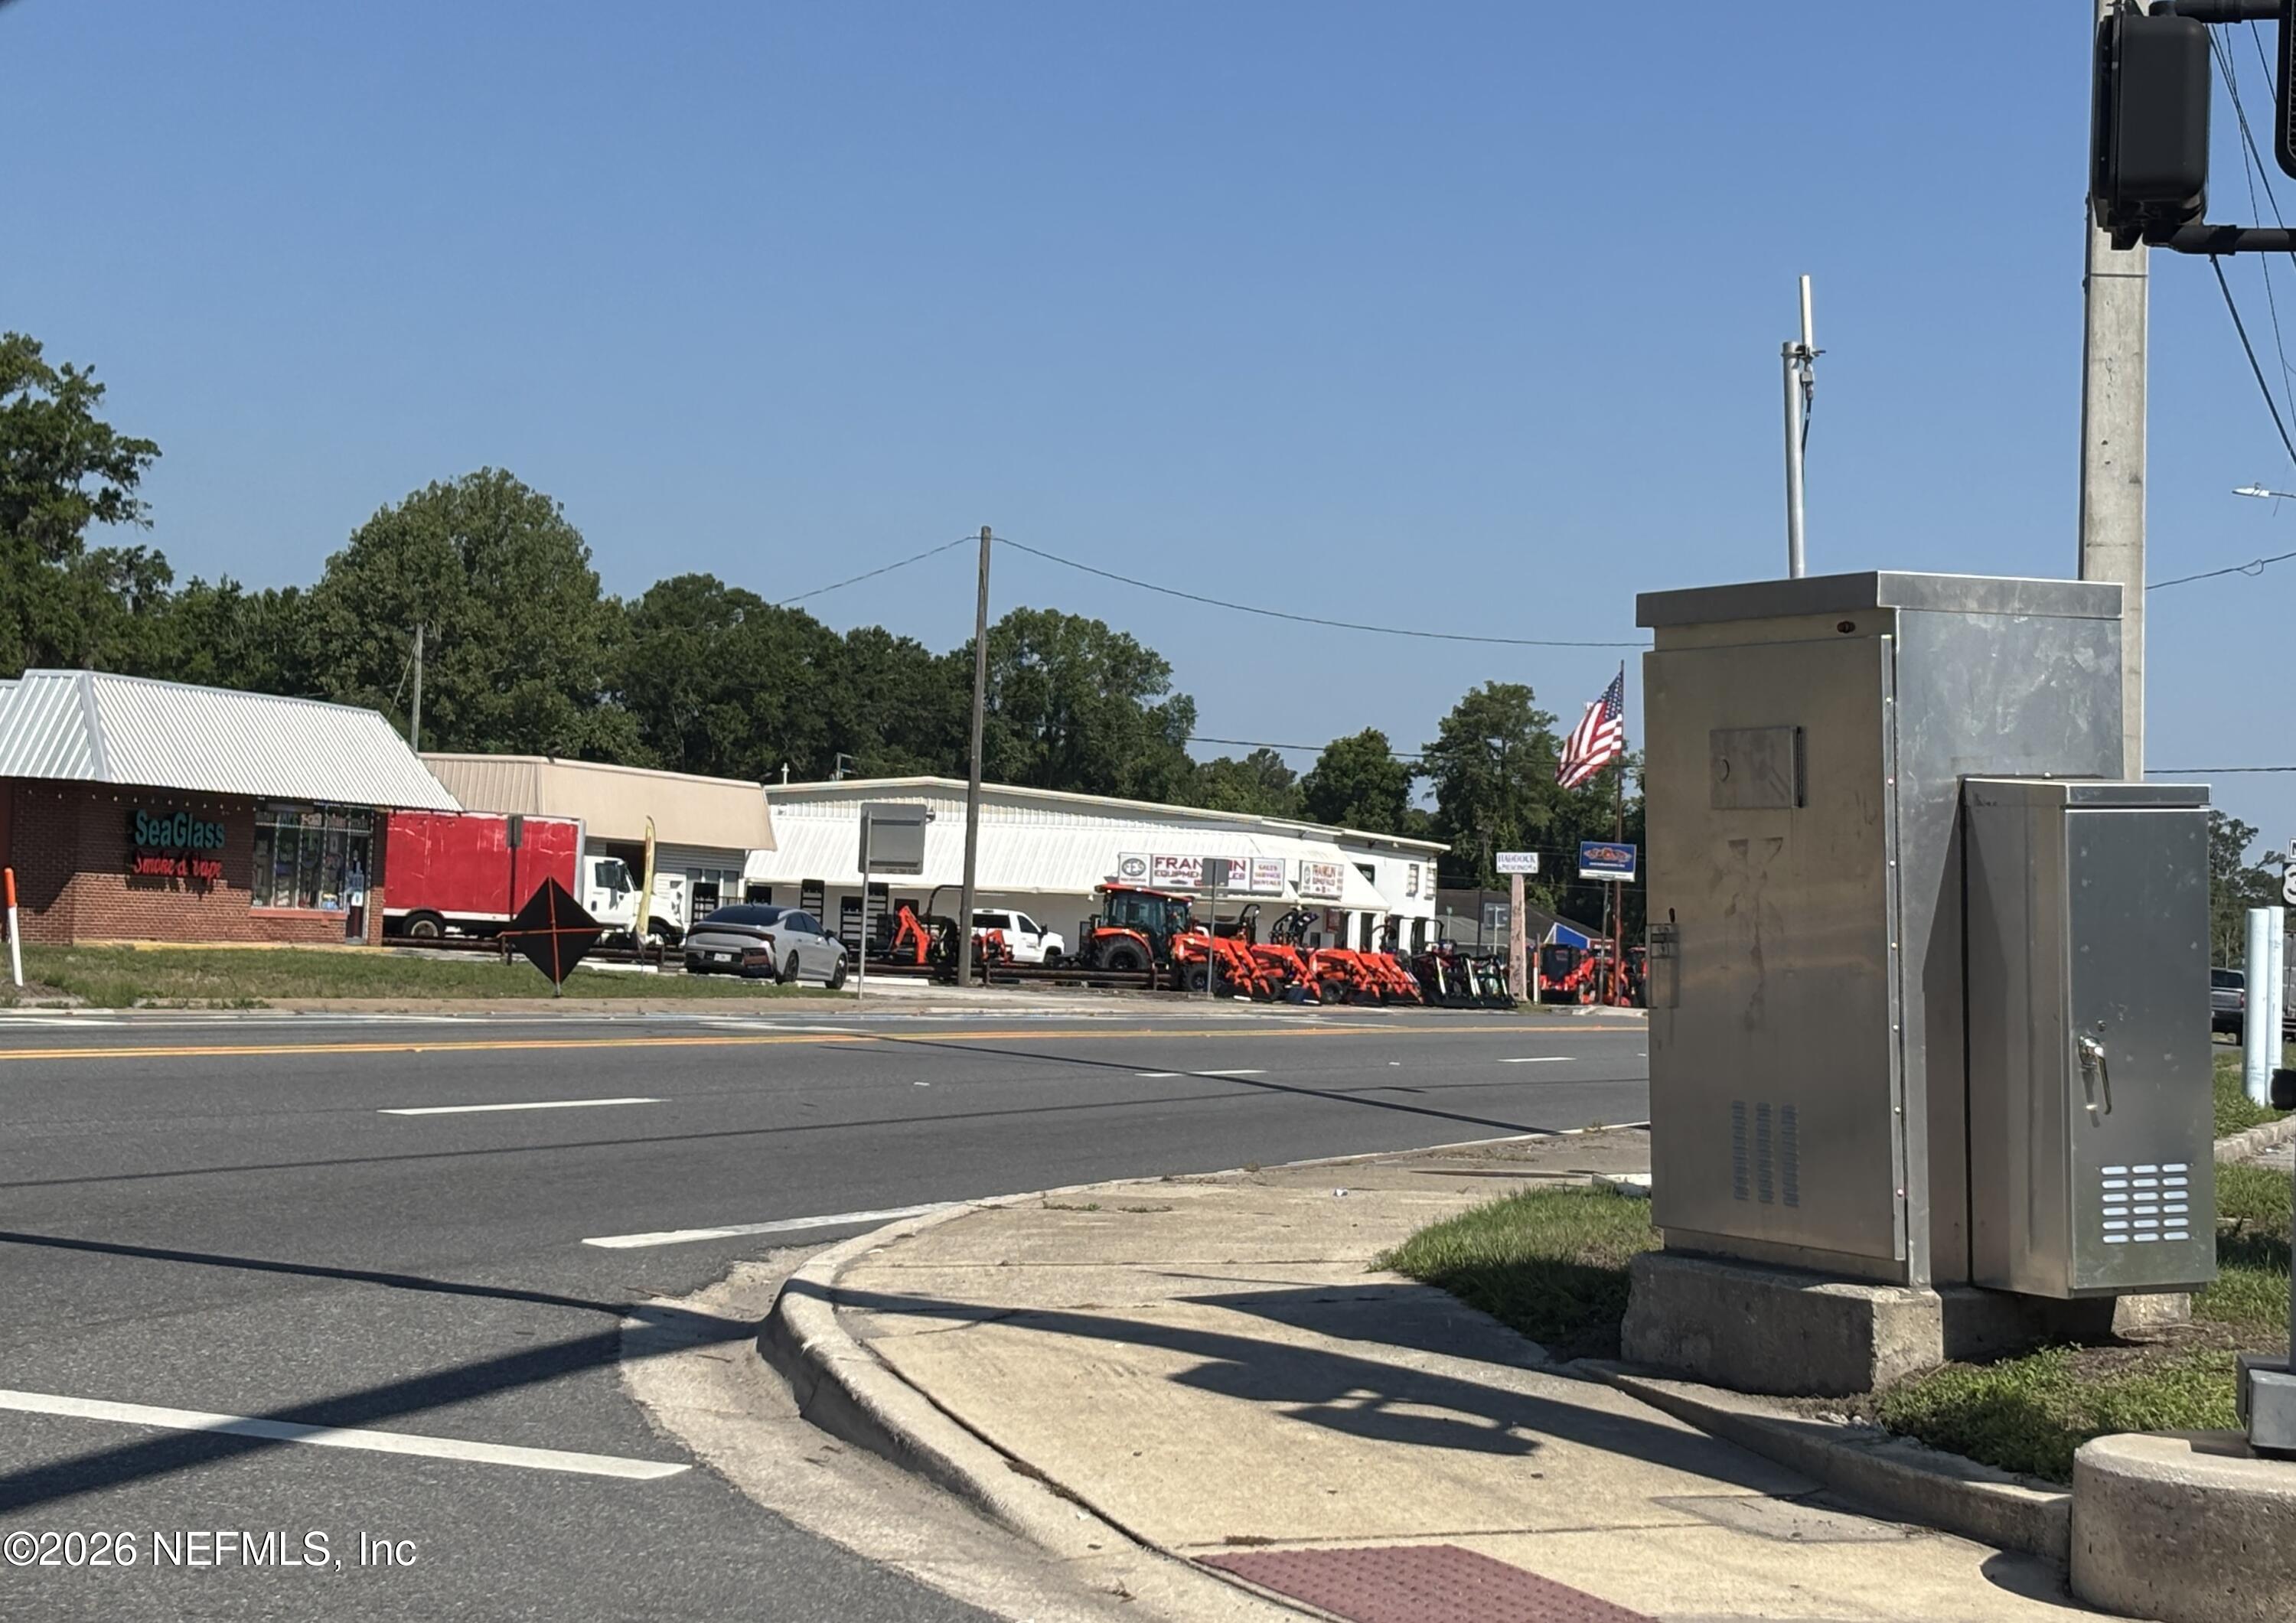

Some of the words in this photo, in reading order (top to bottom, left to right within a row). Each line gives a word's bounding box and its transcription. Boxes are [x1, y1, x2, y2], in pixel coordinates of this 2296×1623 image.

[135, 810, 225, 849] SeaGlass
[132, 852, 174, 875] Smoke
[1154, 857, 1246, 872] FRANIN
